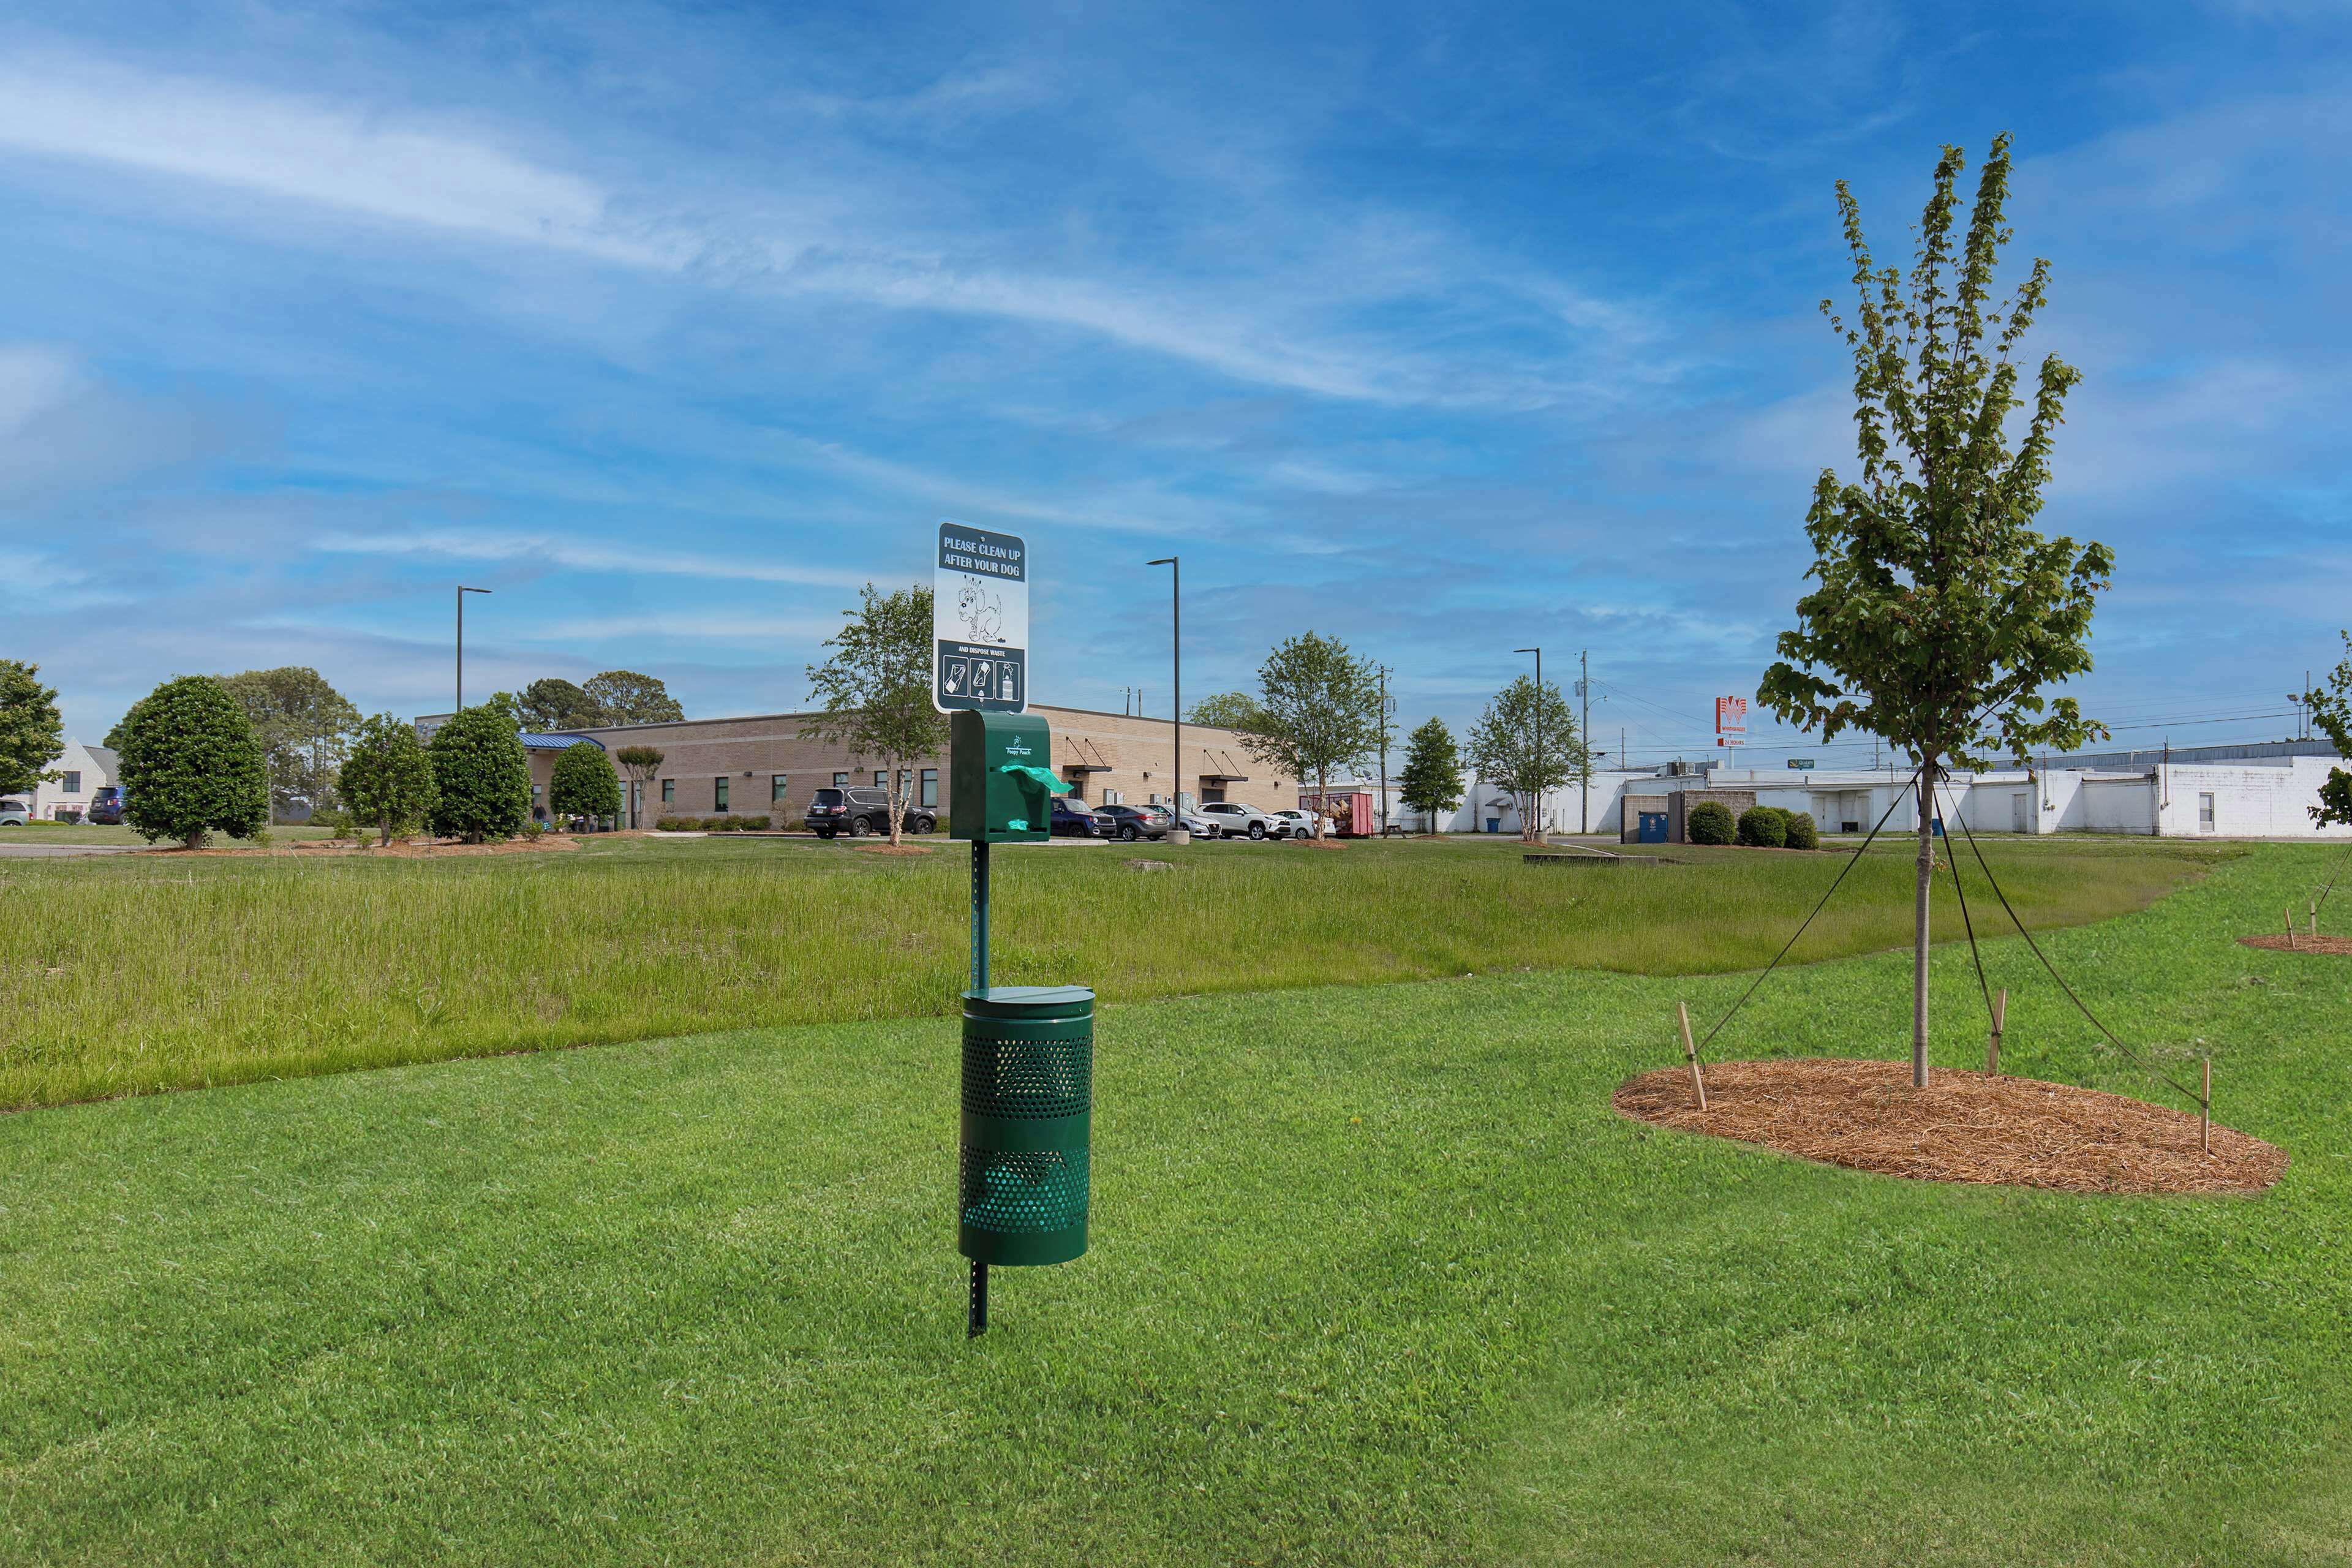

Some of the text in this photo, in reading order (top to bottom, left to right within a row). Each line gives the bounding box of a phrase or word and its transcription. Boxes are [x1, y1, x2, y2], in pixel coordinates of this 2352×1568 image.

[944, 537, 1020, 560] PLEASE CLEAN UP
[944, 553, 1019, 576] AFTER YOUR DOG
[969, 647, 989, 655] DISPOSE
